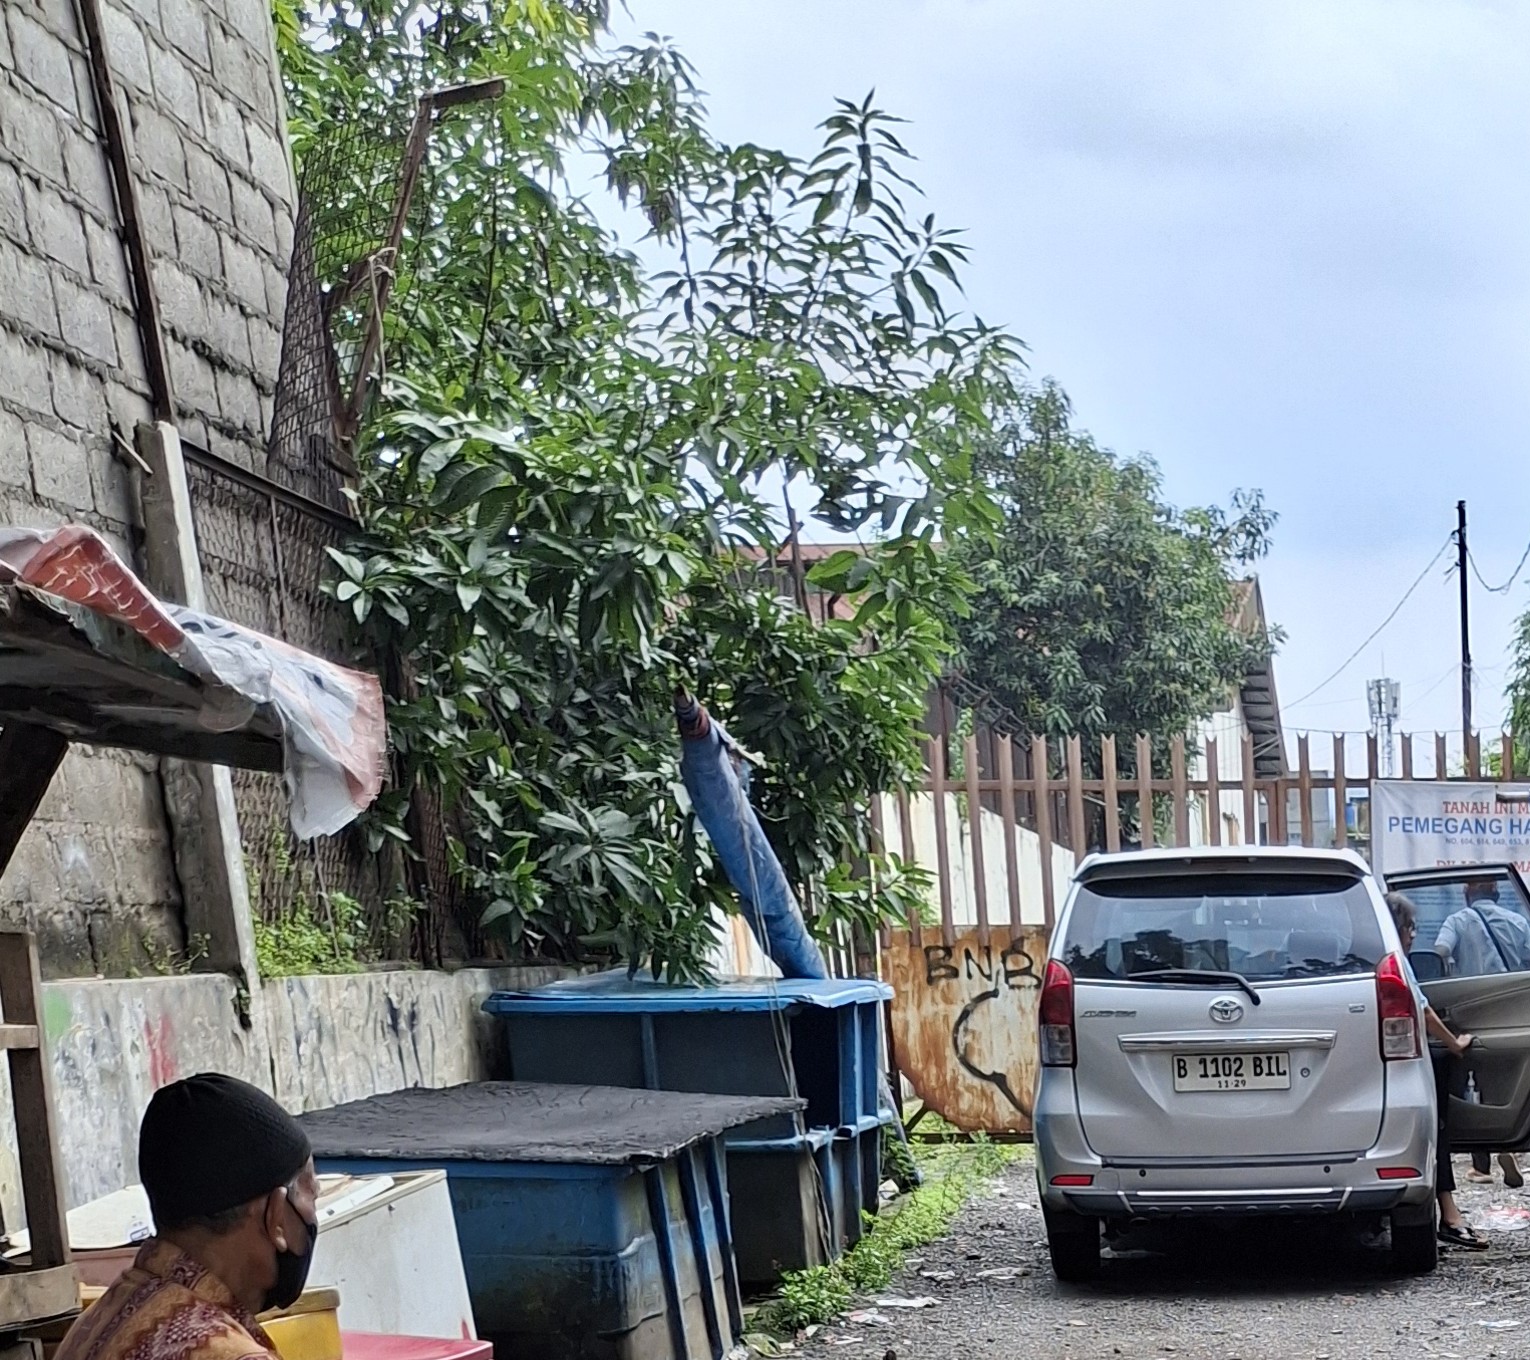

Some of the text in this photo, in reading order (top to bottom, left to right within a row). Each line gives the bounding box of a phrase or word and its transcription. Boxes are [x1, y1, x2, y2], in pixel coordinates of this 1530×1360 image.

[1443, 801, 1490, 814] TANAH
[1494, 801, 1514, 814] INI
[1388, 816, 1503, 835] PEMEGANG
[1177, 1055, 1287, 1078] B 1102 BIL
